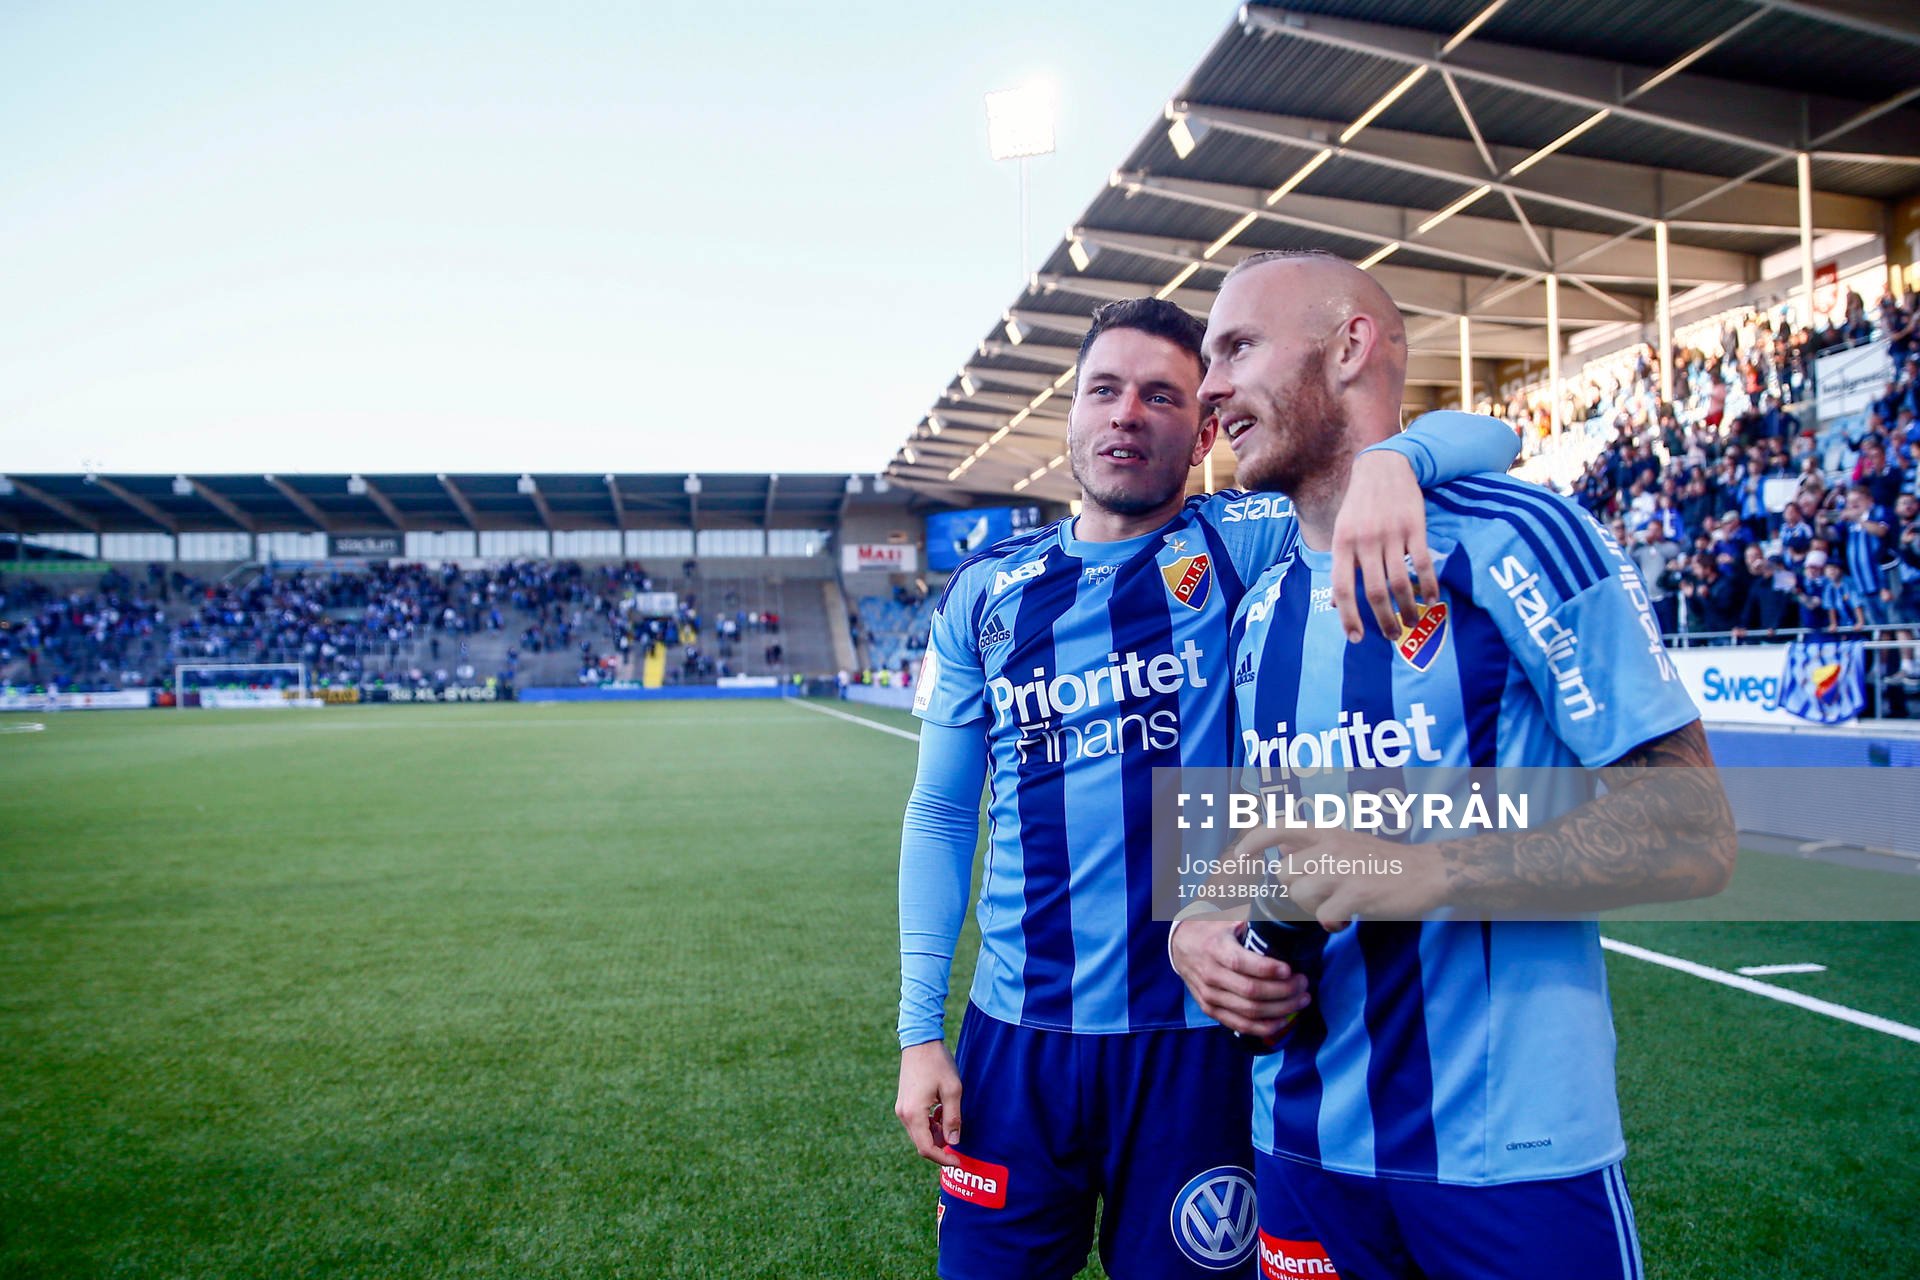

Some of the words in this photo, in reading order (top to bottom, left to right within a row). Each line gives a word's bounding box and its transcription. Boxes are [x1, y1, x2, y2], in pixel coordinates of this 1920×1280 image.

[980, 630, 1011, 649] adidas
[987, 639, 1208, 728] Prioritet
[1015, 709, 1180, 765] Finans
[1241, 702, 1443, 783] Prioritet
